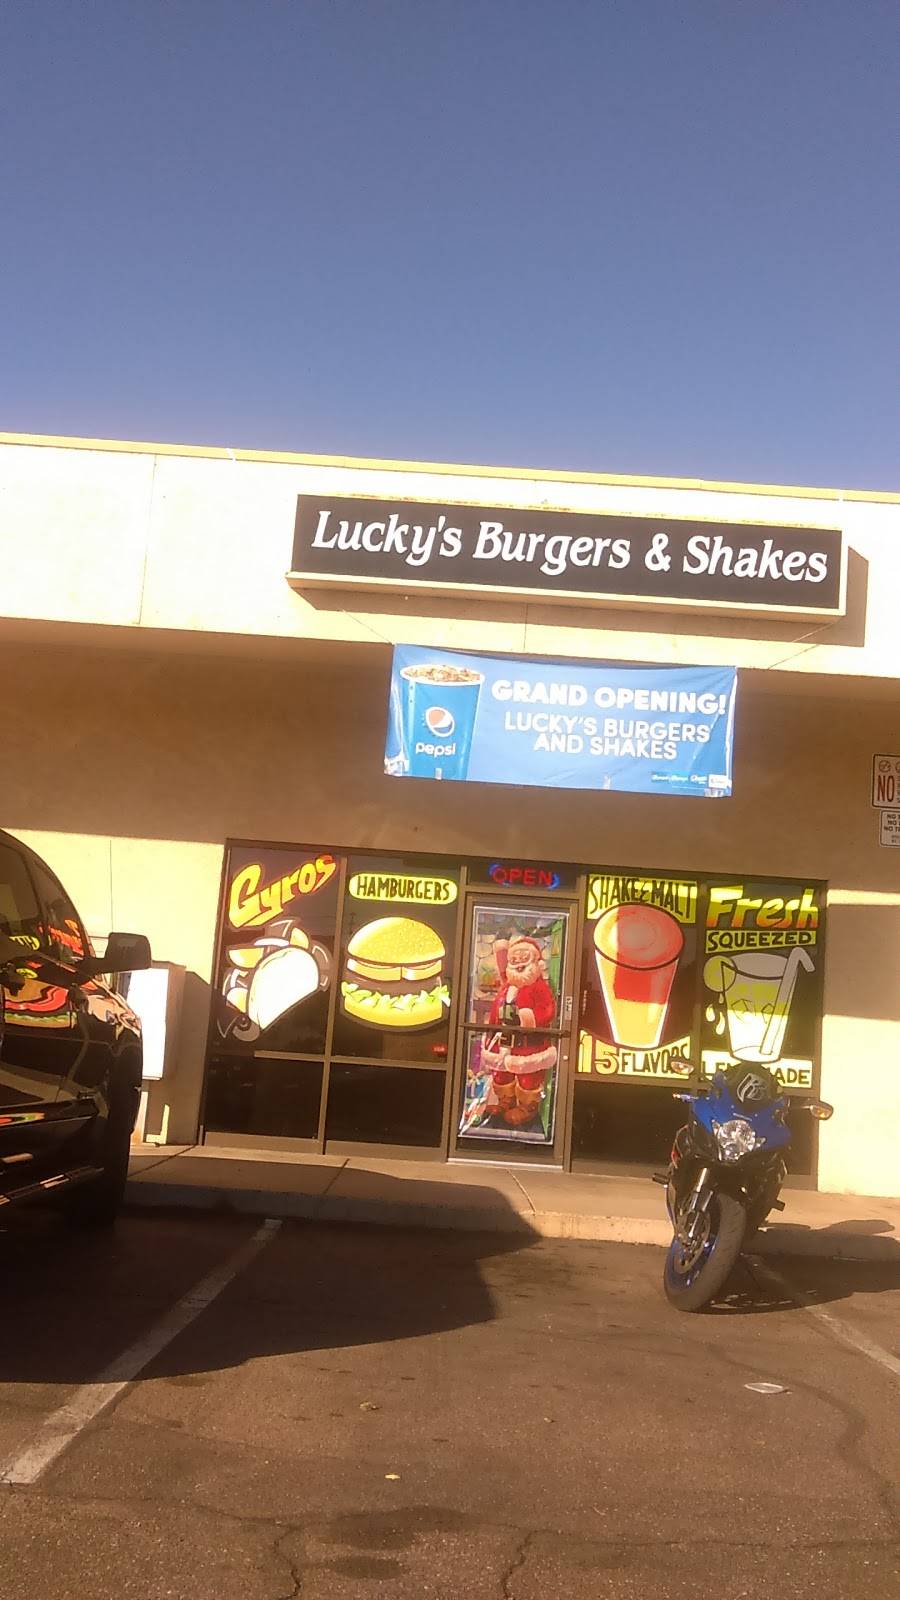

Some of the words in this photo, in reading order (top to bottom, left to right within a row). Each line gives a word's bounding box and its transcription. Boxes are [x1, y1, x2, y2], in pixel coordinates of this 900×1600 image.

[311, 510, 462, 567] Lucky's
[473, 521, 631, 576] Burgers
[644, 533, 671, 572] &
[683, 535, 828, 583] Shakes
[491, 679, 588, 707] GRAND
[594, 686, 727, 715] OPENING!
[505, 712, 597, 735] LUCKY'S
[604, 718, 710, 743] BURGERS
[415, 742, 456, 758] pepsi
[533, 733, 584, 754] AND
[590, 738, 678, 760] SHAKES
[877, 775, 895, 802] NO
[356, 875, 450, 902] HAMBURGERS
[491, 866, 553, 886] OPEN
[228, 853, 337, 929] Gyros
[706, 886, 819, 928] Fresh
[707, 931, 812, 951] SQUEEZED
[578, 1030, 619, 1075] 15
